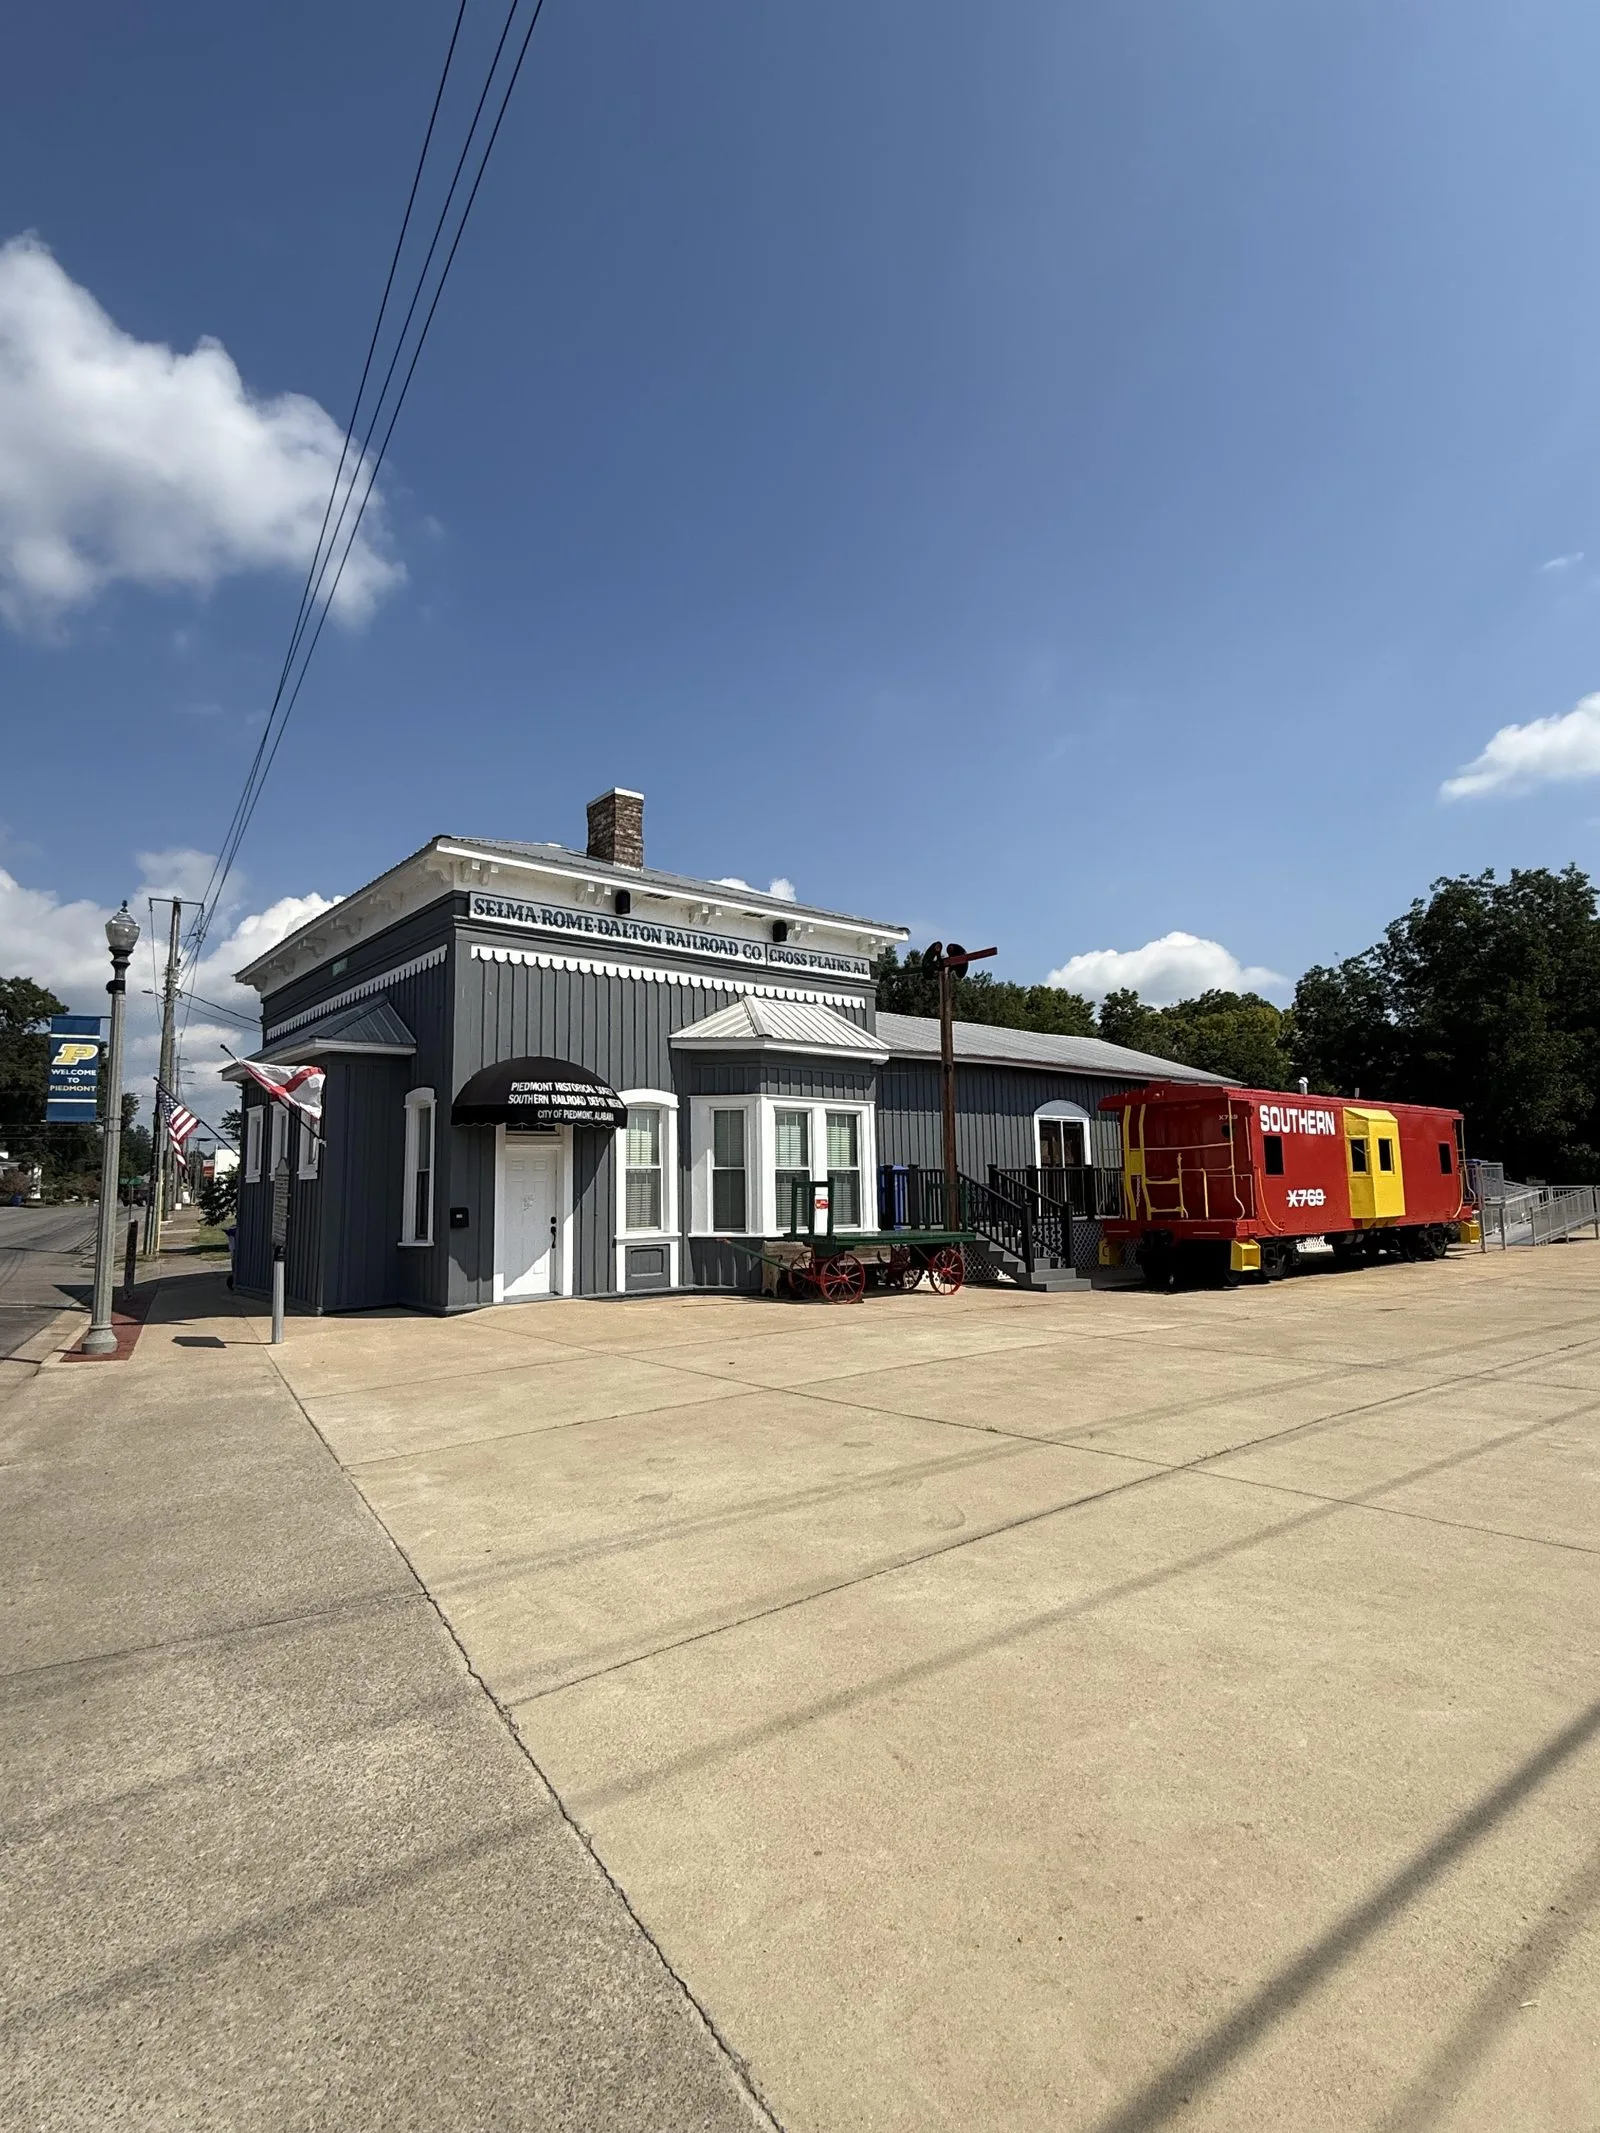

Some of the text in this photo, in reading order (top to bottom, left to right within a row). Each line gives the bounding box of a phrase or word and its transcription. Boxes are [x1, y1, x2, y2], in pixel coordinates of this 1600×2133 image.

[666, 930, 739, 956] RAILROAD
[769, 949, 807, 966] CROSS
[51, 1043, 98, 1065] P
[510, 1082, 553, 1092] PIEDMONT
[554, 1082, 597, 1094] HISTORICAL
[508, 1094, 549, 1105] SOUTHERN
[551, 1094, 587, 1106] RAILROAD
[537, 1110, 553, 1119] CITY
[553, 1110, 562, 1118] OF
[1259, 1104, 1336, 1135] SOUTHERN
[1286, 1189, 1326, 1208] X769
